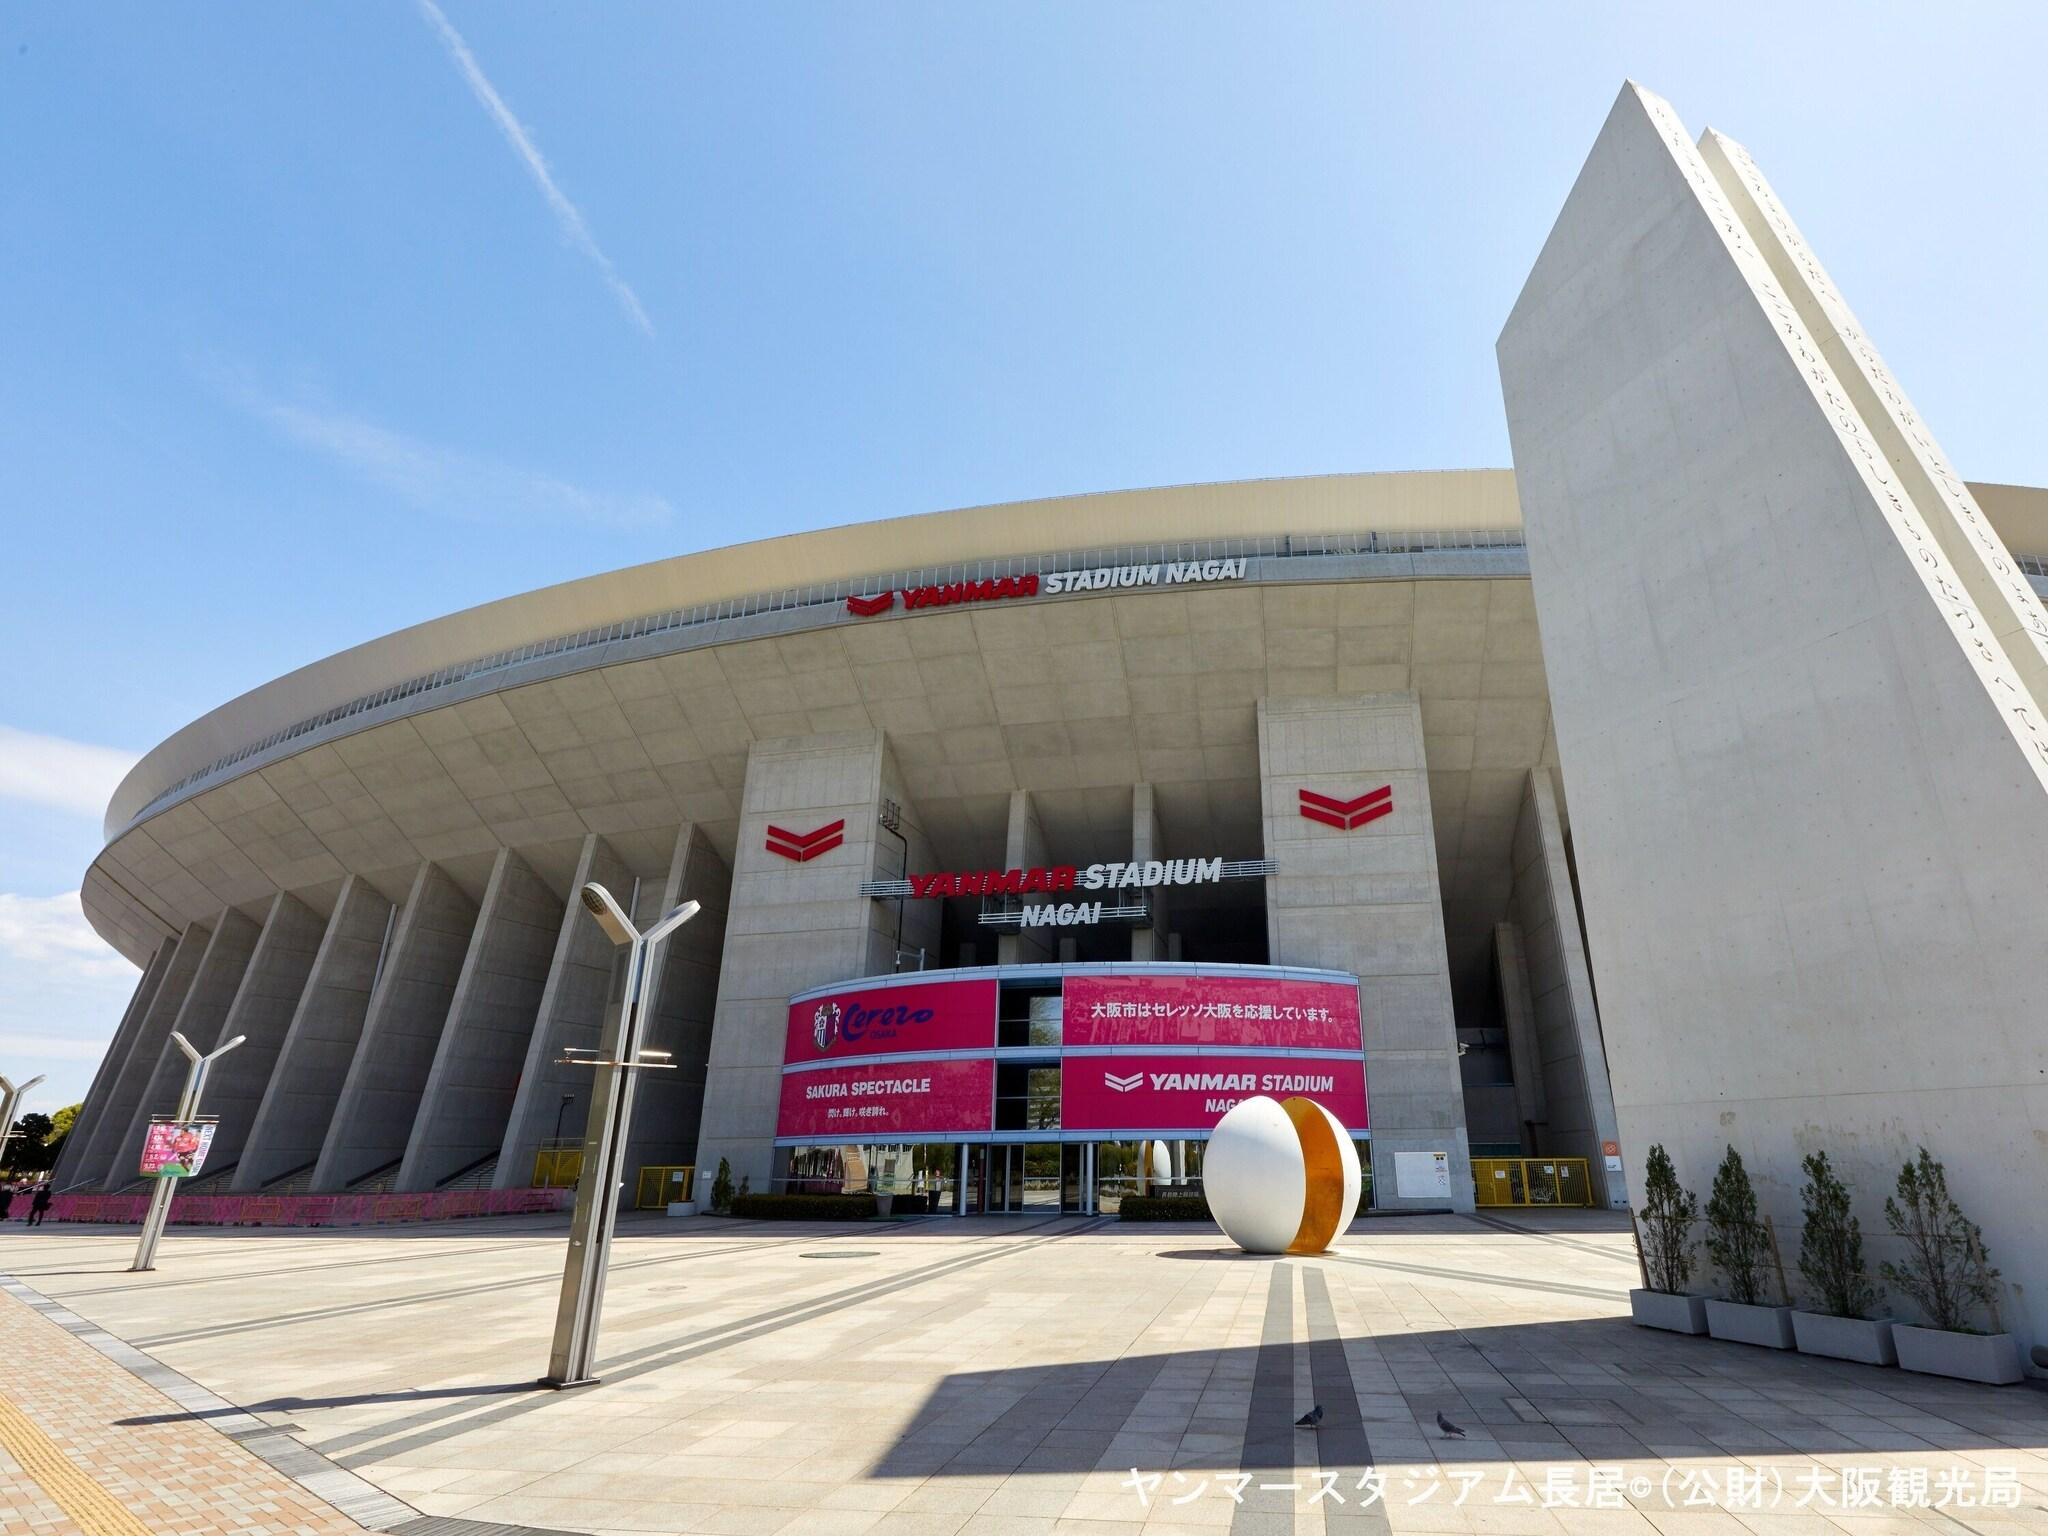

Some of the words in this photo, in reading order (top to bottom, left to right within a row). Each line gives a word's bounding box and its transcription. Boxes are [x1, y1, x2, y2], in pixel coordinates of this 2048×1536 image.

[901, 574, 1040, 610] YANMAR
[1045, 564, 1159, 594] STADIUM
[1165, 558, 1248, 584] NAGAI
[909, 865, 1078, 898] YANMAR
[1083, 857, 1222, 889] STADIUM
[1020, 902, 1102, 927] NAGAI
[842, 1003, 934, 1041] Cerezo
[1091, 1002, 1334, 1023] 大阪市はセレッソ大阪を応援しています。
[806, 1083, 848, 1099] SAKURA
[851, 1078, 931, 1096] SPECTACLE
[1149, 1073, 1257, 1091] YANMAR
[1261, 1074, 1334, 1092] STADIUM
